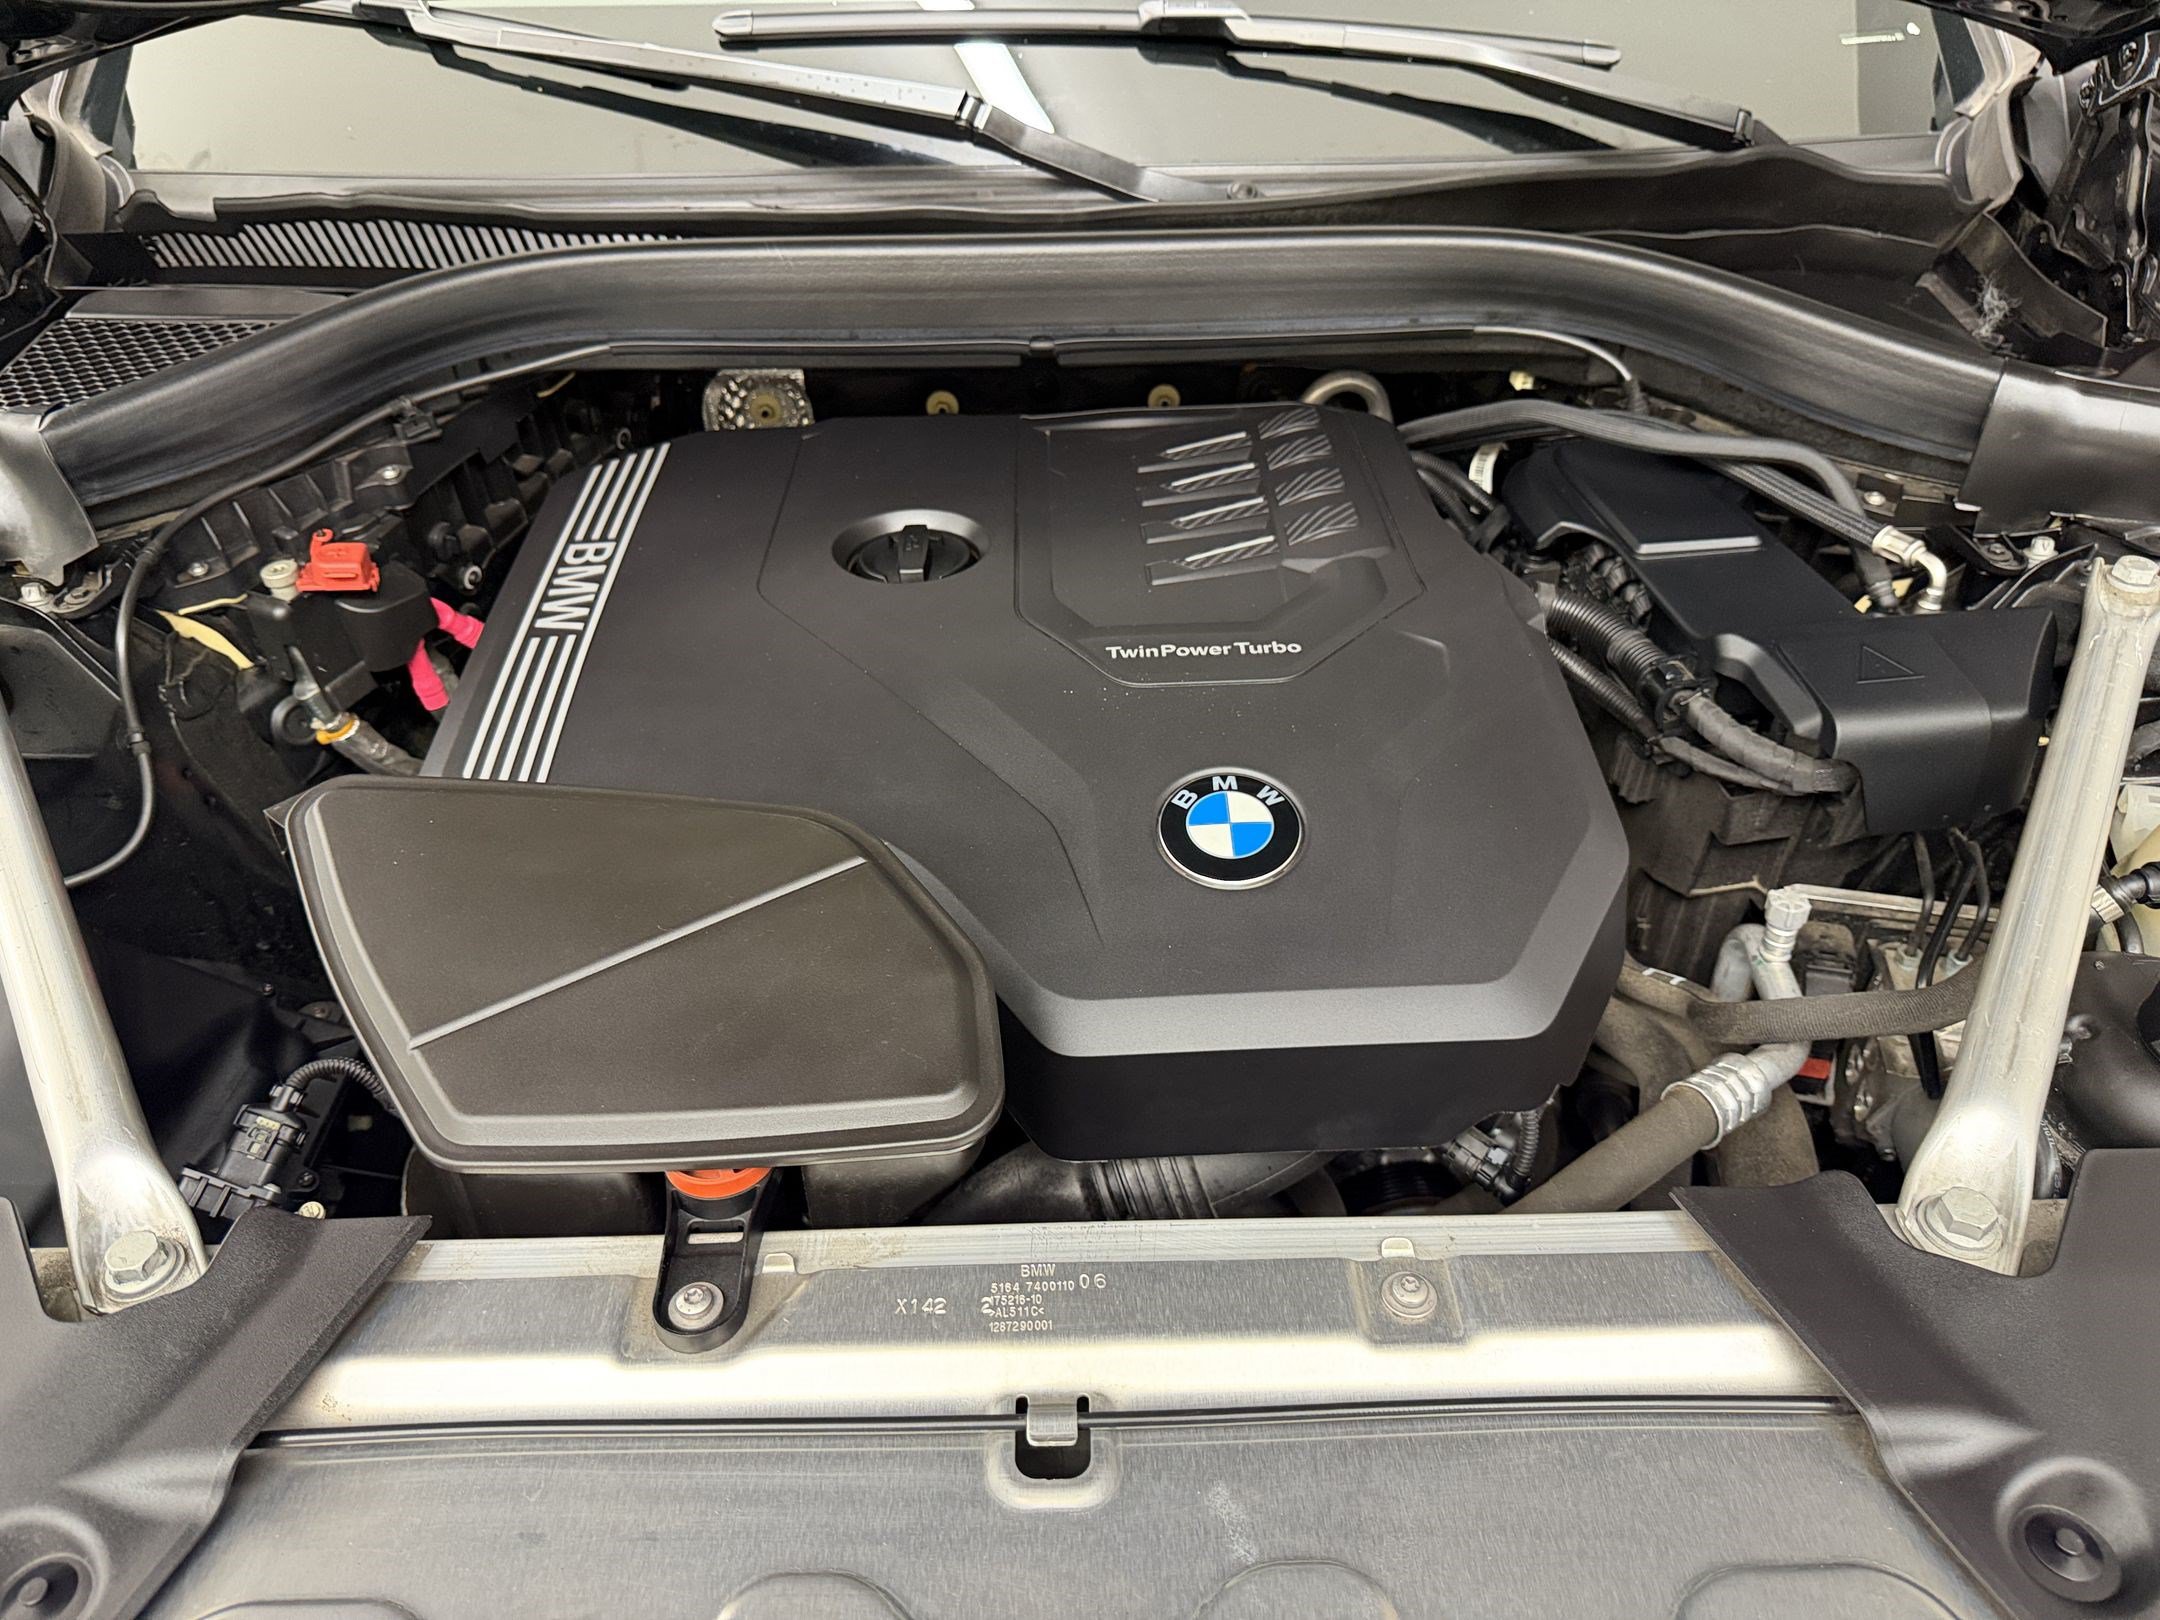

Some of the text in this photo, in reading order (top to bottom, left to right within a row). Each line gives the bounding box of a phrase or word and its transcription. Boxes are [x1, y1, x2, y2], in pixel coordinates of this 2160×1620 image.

[535, 541, 616, 631] BMW
[1233, 640, 1302, 655] Turbo
[1170, 775, 1285, 810] BMW
[1020, 1263, 1056, 1278] BMW
[990, 1280, 1075, 1294] 5164 7400110
[895, 1297, 947, 1316] X142
[989, 1319, 1053, 1333] 1287290001
